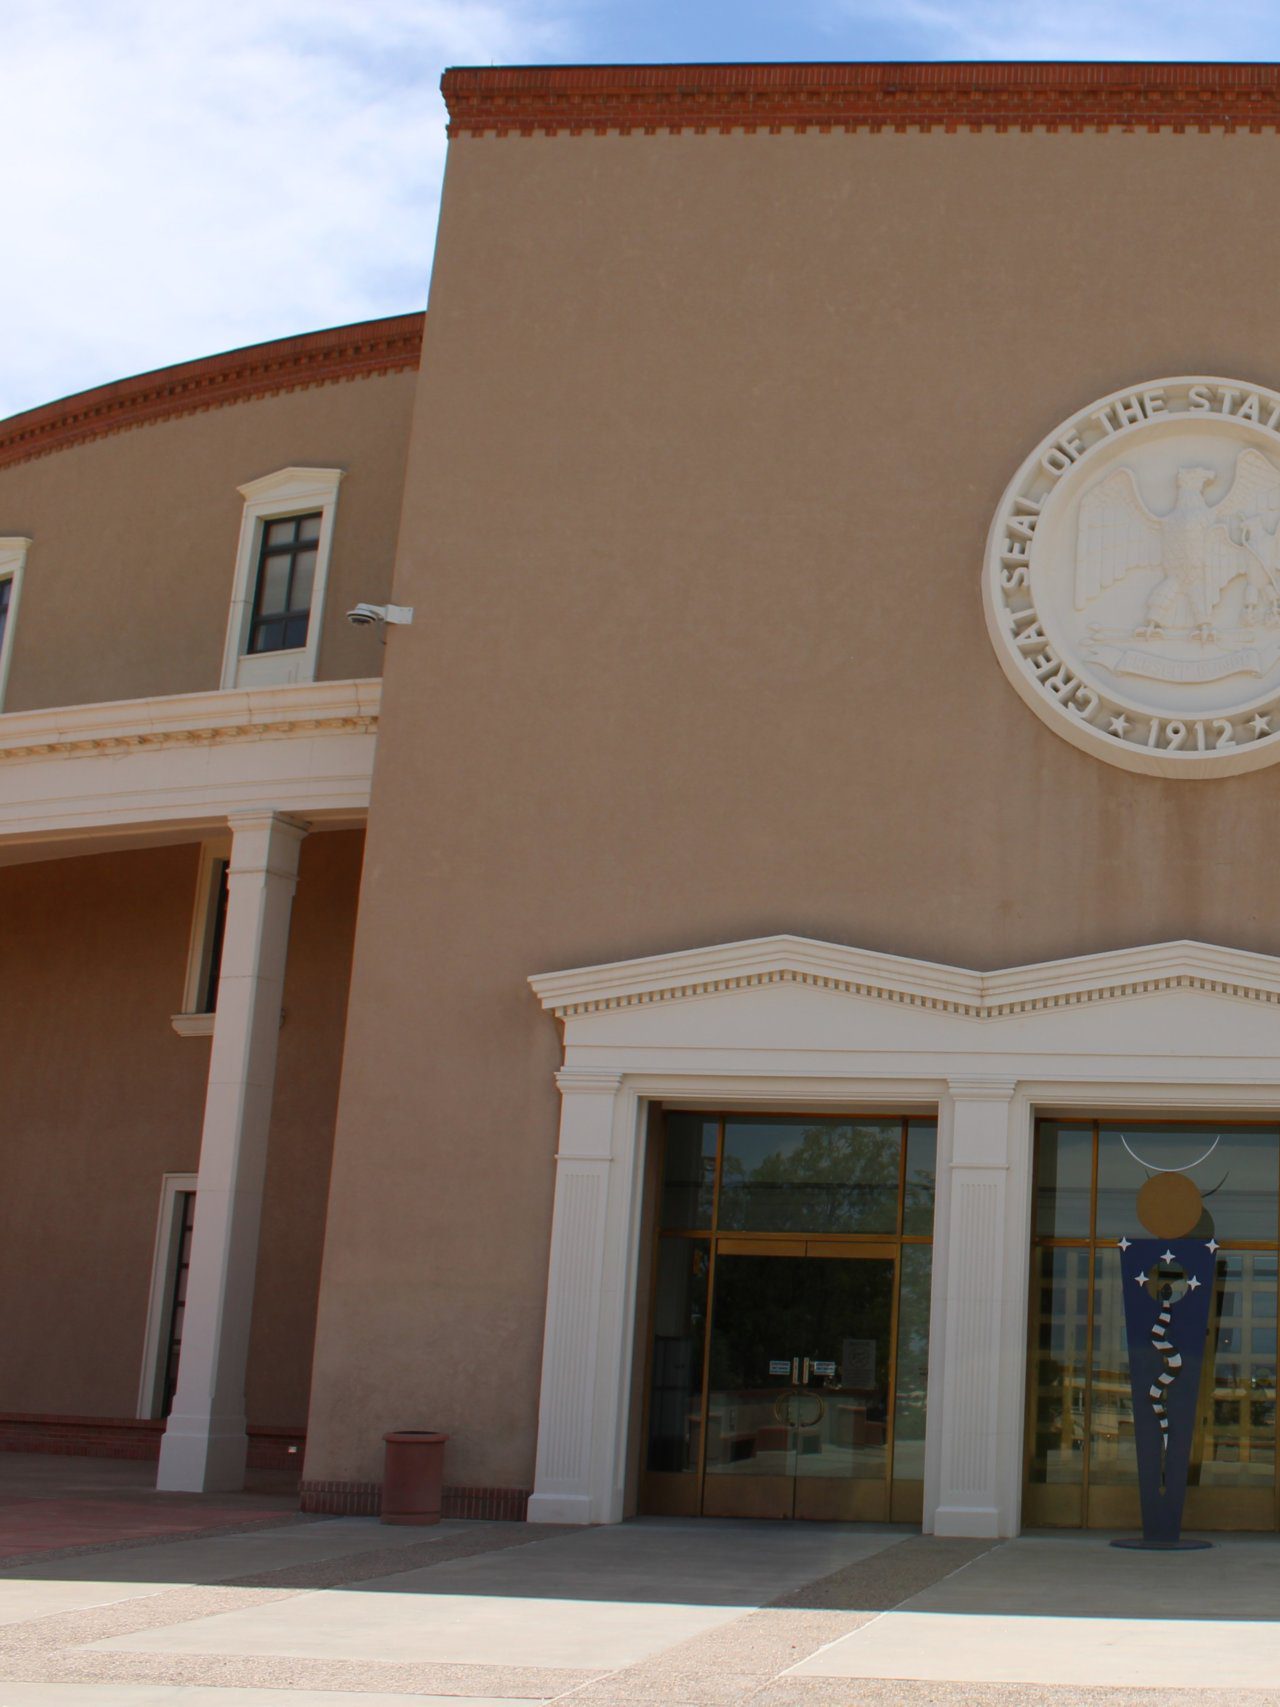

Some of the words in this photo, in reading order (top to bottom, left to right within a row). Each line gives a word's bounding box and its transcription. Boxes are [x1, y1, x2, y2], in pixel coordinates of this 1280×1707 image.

[1091, 389, 1167, 435] THE
[1041, 428, 1084, 476] OF
[1000, 493, 1049, 588] SEAL
[1004, 607, 1099, 719] GREAT
[1147, 718, 1237, 751] 1912
